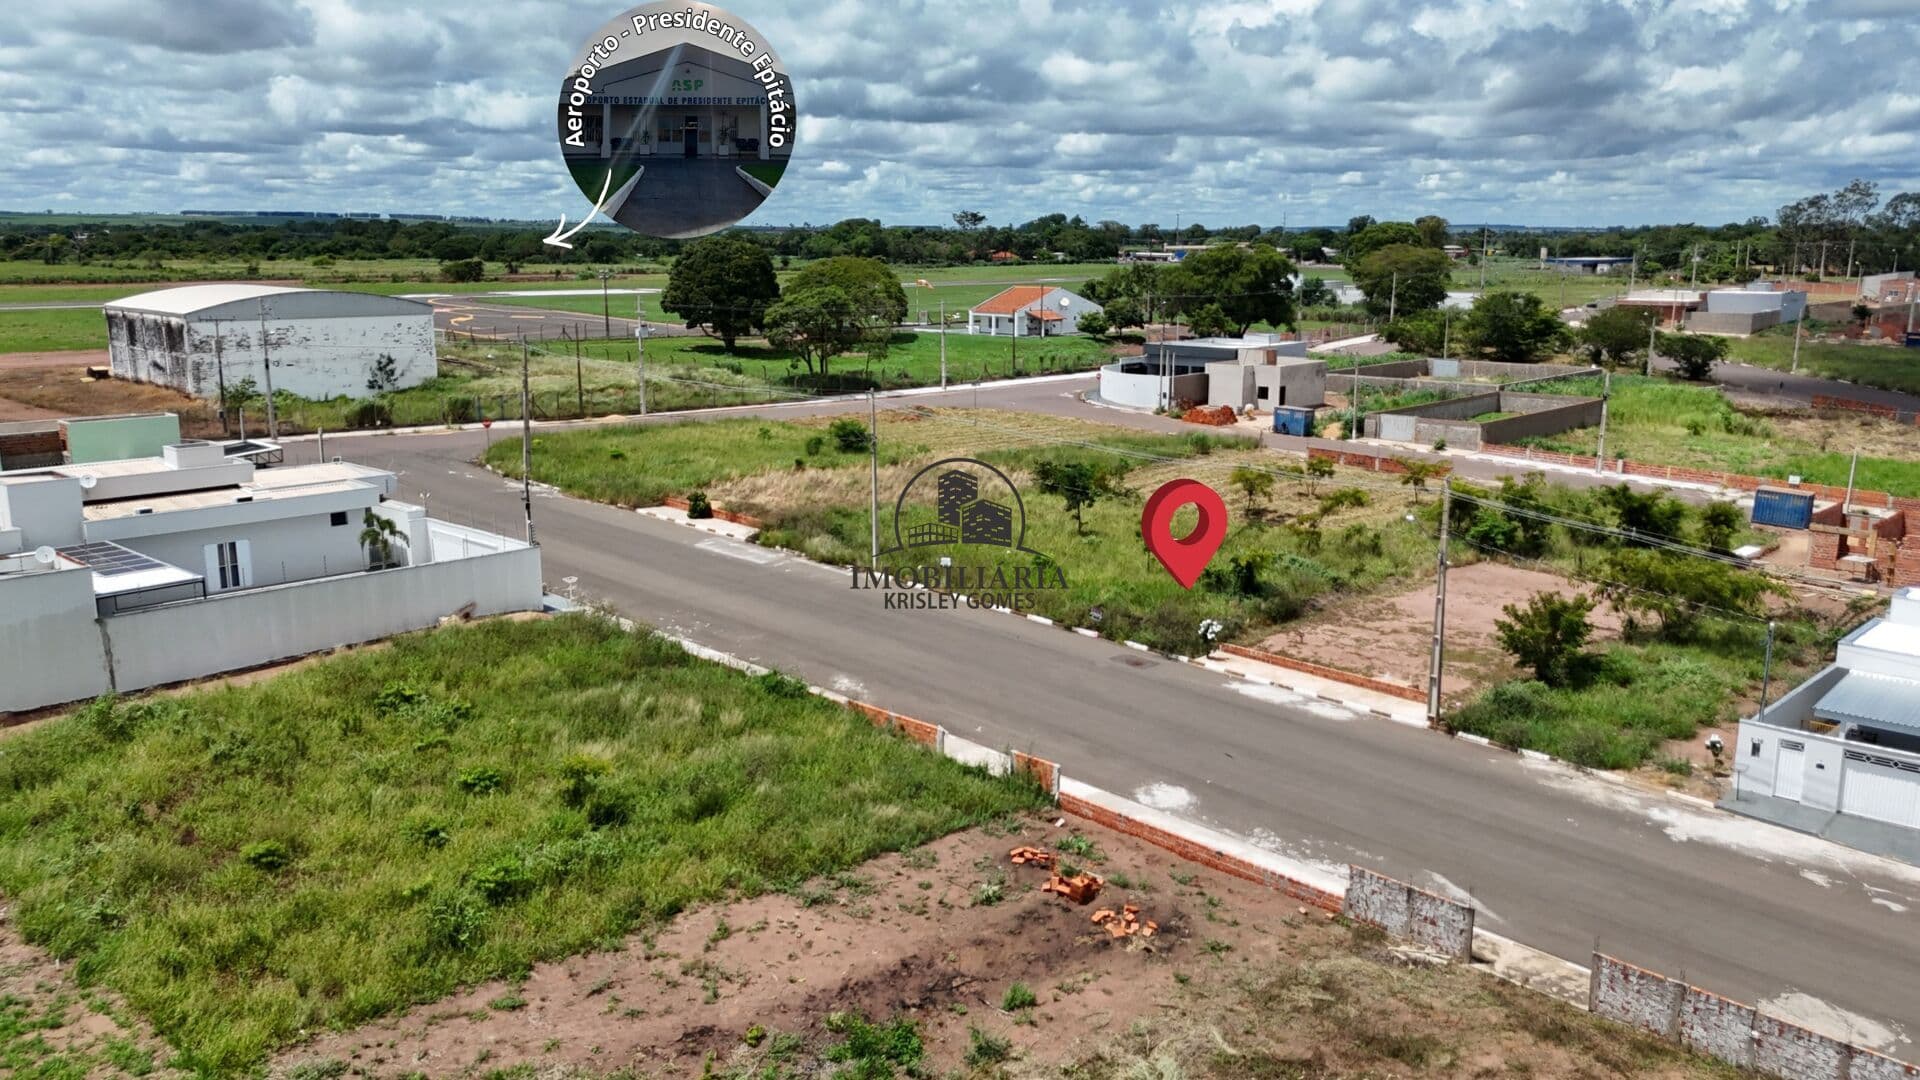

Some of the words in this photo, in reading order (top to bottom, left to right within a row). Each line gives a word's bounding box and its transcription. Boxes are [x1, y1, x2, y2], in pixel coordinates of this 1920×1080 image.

[668, 96, 677, 104] DE
[682, 96, 733, 104] PRESIDENTE
[736, 95, 765, 104] EPITÁC
